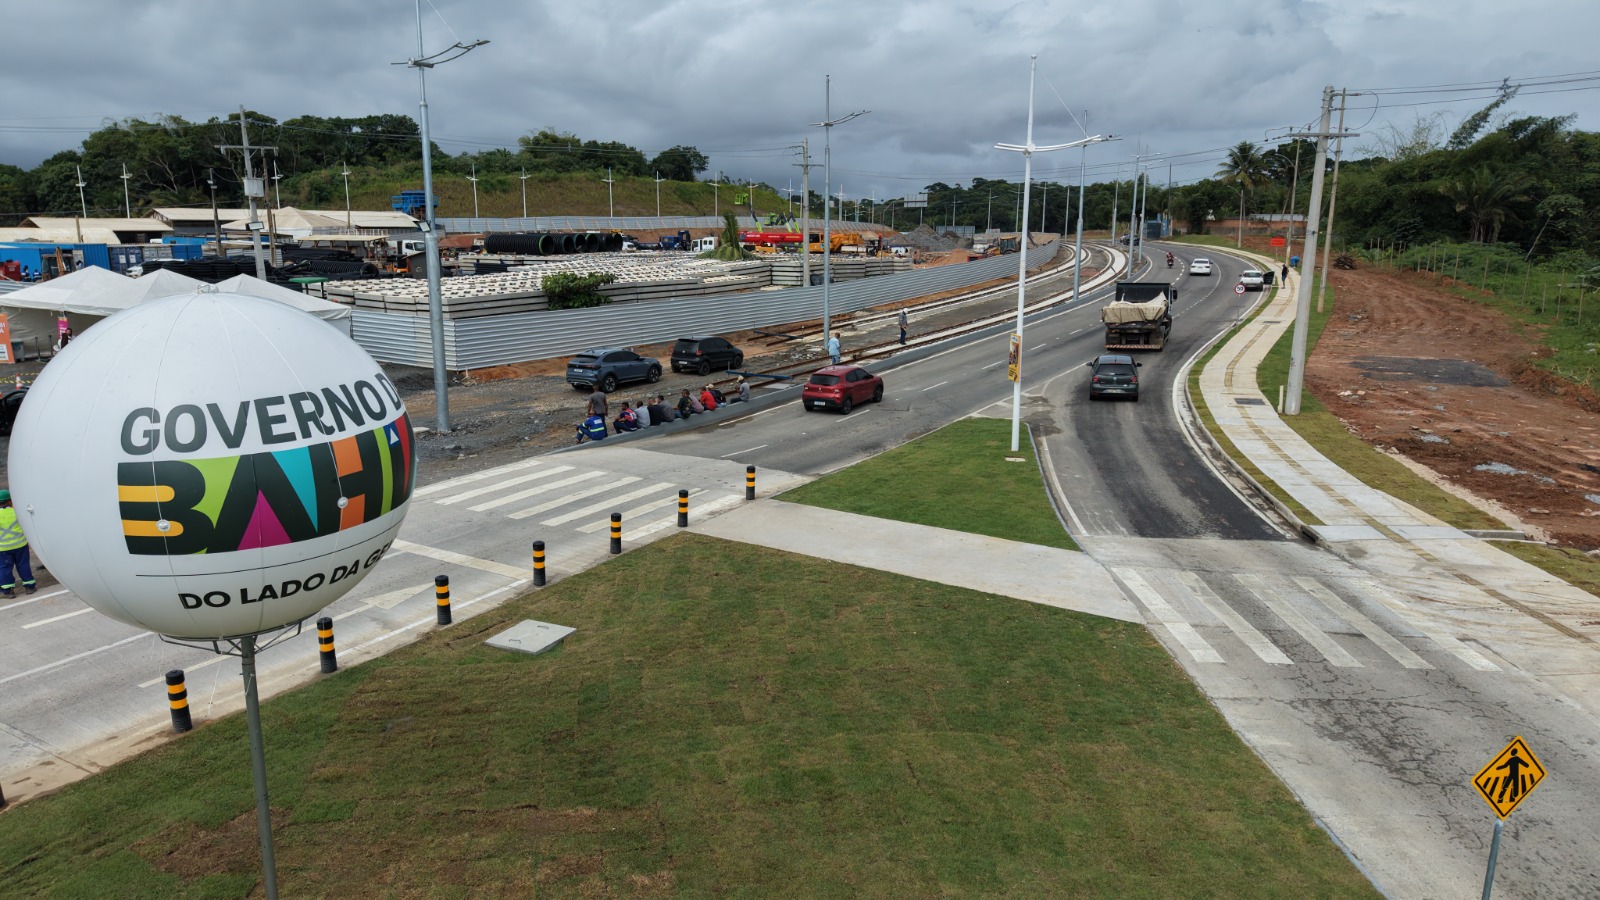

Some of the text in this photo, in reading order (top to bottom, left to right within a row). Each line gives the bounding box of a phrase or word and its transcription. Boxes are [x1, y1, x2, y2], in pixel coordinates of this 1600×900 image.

[121, 373, 402, 455] GOVERNO D
[178, 591, 231, 609] DO
[240, 573, 326, 604] LADO
[329, 559, 360, 584] DA
